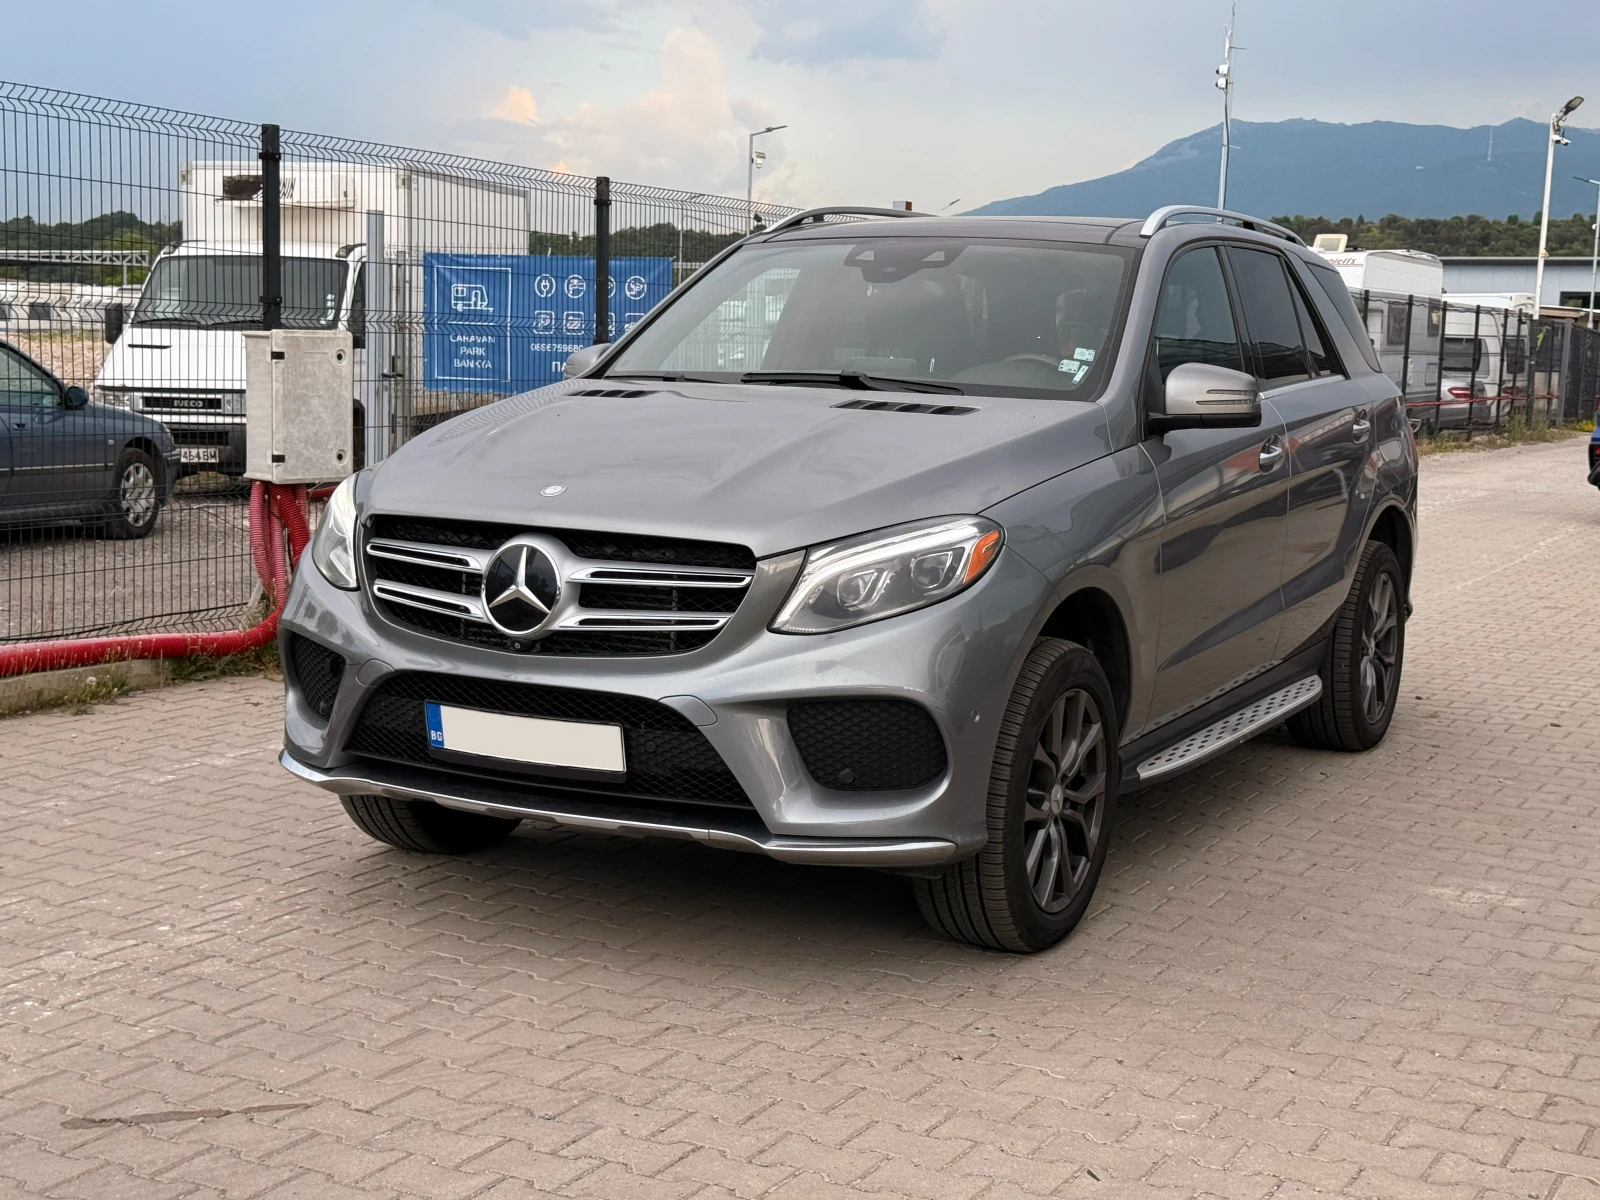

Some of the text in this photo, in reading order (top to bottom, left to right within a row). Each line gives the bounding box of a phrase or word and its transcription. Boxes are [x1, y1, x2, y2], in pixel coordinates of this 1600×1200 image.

[460, 346, 486, 356] PARK
[453, 358, 493, 369] BANKYA
[174, 400, 203, 408] IVECO
[430, 730, 443, 741] BG
